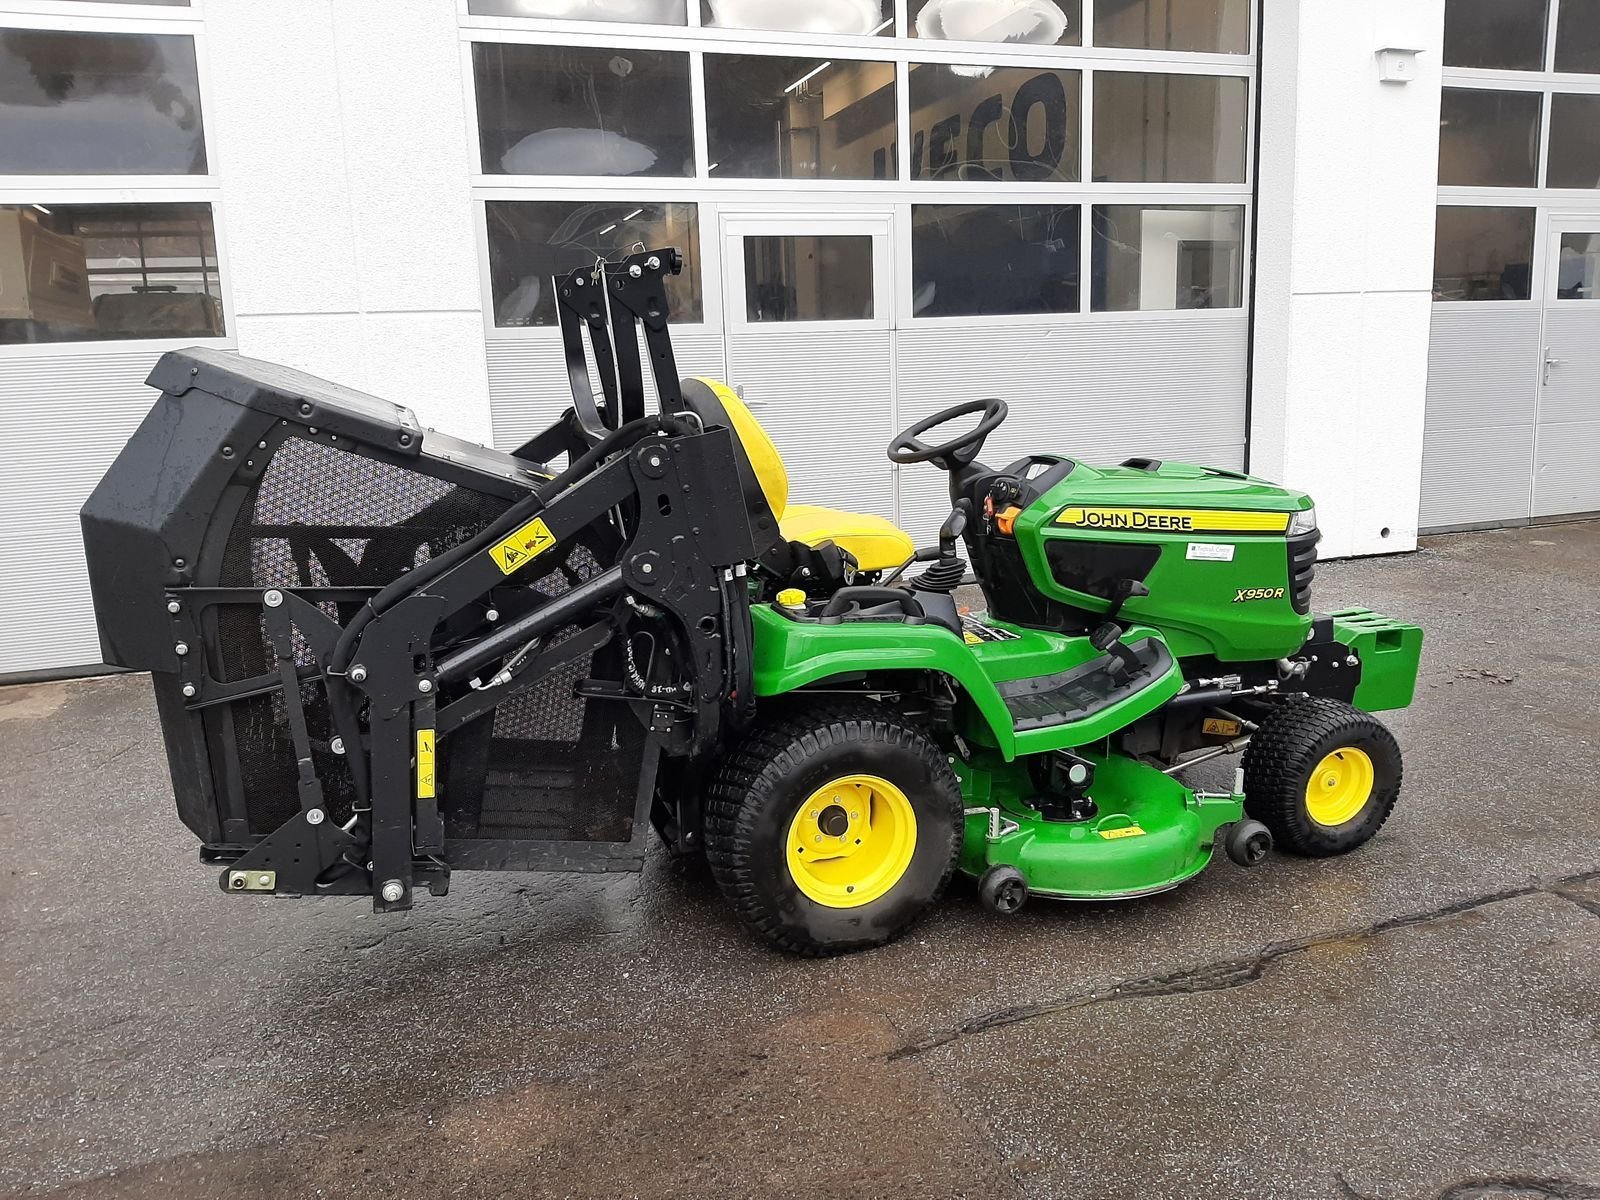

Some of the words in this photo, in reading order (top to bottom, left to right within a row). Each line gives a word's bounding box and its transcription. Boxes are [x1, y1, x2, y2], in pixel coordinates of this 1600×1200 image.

[1076, 509, 1128, 526] JOHN
[1132, 511, 1193, 529] DEERE
[1233, 587, 1285, 602] X950R
